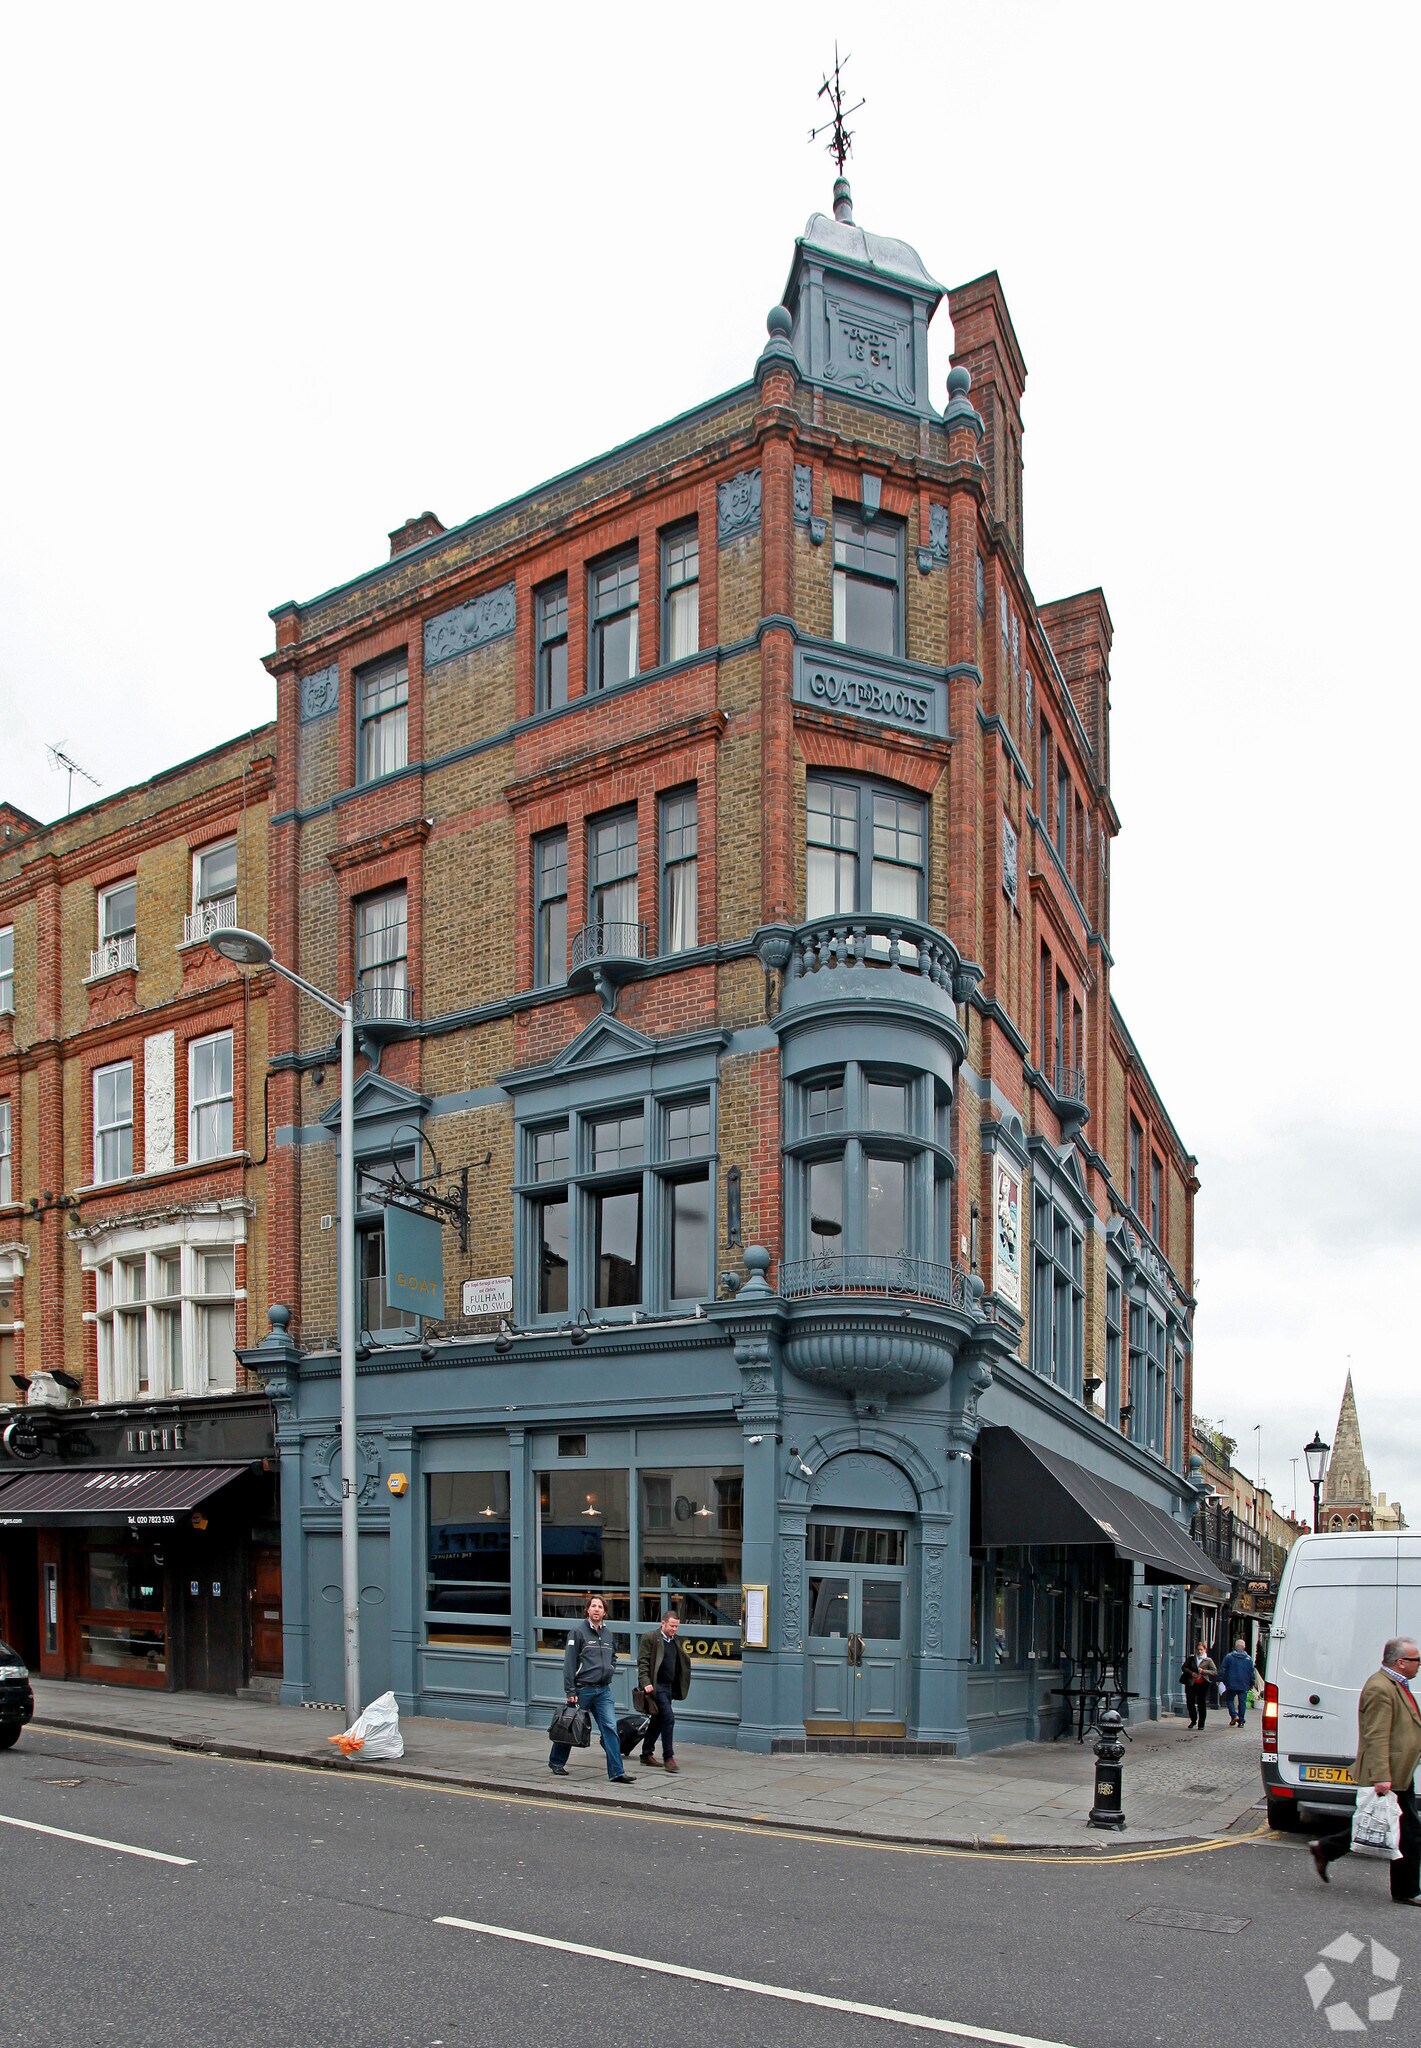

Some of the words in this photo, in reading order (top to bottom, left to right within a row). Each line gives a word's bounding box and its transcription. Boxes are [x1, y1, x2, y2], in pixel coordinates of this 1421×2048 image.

[810, 673, 862, 708] GOAT
[860, 687, 871, 700] IN
[866, 683, 929, 723] BOOTS
[396, 1271, 439, 1297] GOAT
[470, 1292, 505, 1303] FULHAM
[465, 1303, 489, 1314] ROAD
[126, 1423, 184, 1452] HACHÉ
[136, 1516, 148, 1524] 020
[148, 1516, 161, 1524] 7823
[161, 1515, 175, 1524] 3515
[682, 1639, 734, 1657] GOAT
[1308, 1767, 1342, 1780] DE57
